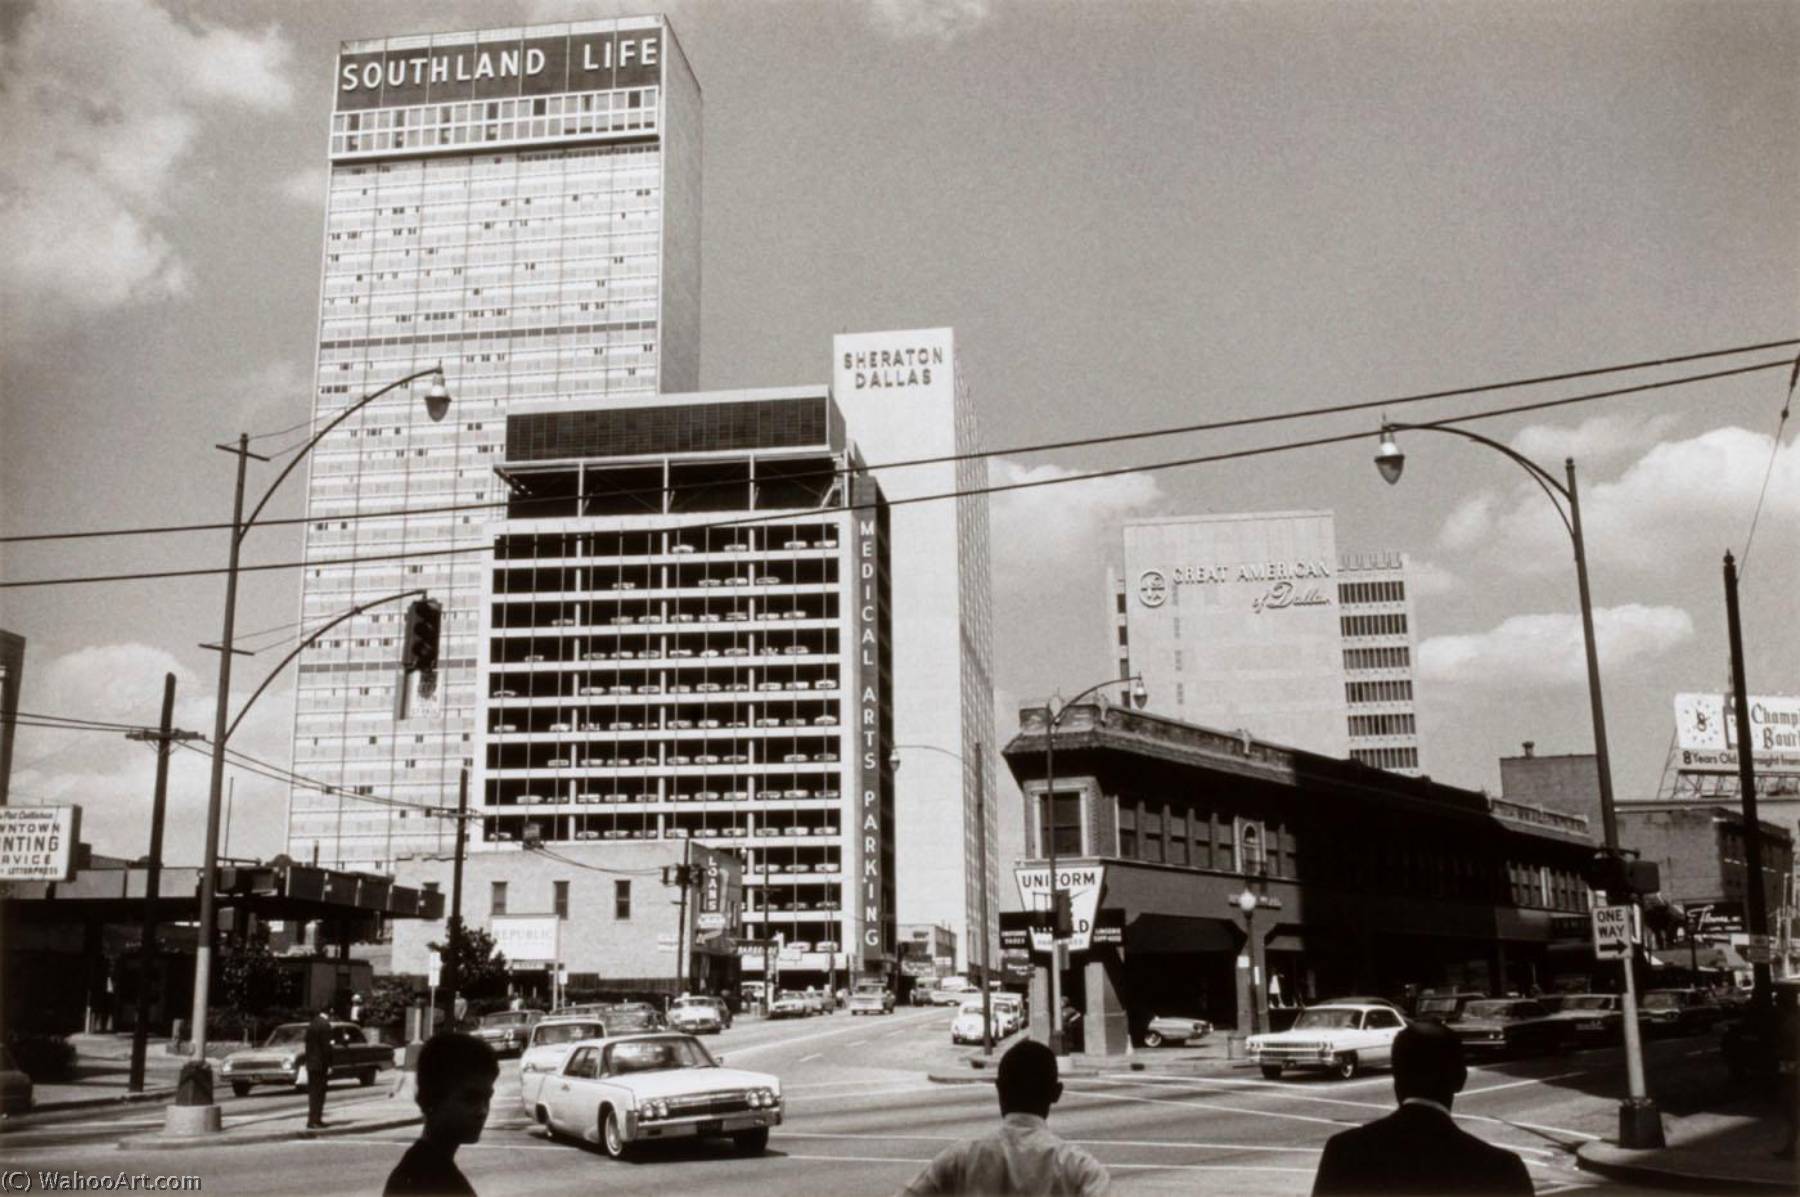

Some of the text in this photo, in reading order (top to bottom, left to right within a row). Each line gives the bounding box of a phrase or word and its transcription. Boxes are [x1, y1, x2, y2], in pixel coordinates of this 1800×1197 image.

[342, 38, 658, 91] SOUTHLAND LIFE
[844, 346, 942, 370] SHERATON
[855, 368, 932, 389] DALLAS
[1172, 561, 1331, 585] GREAT AMERICAN
[1751, 702, 1800, 728] Champ
[860, 521, 878, 946] MEDICAL ARTS PARKING
[0, 836, 59, 851] NTING
[707, 855, 718, 911] LOANS
[1022, 872, 1095, 888] UNIORM
[1597, 909, 1624, 922] ONE
[1599, 925, 1625, 937] WAY
